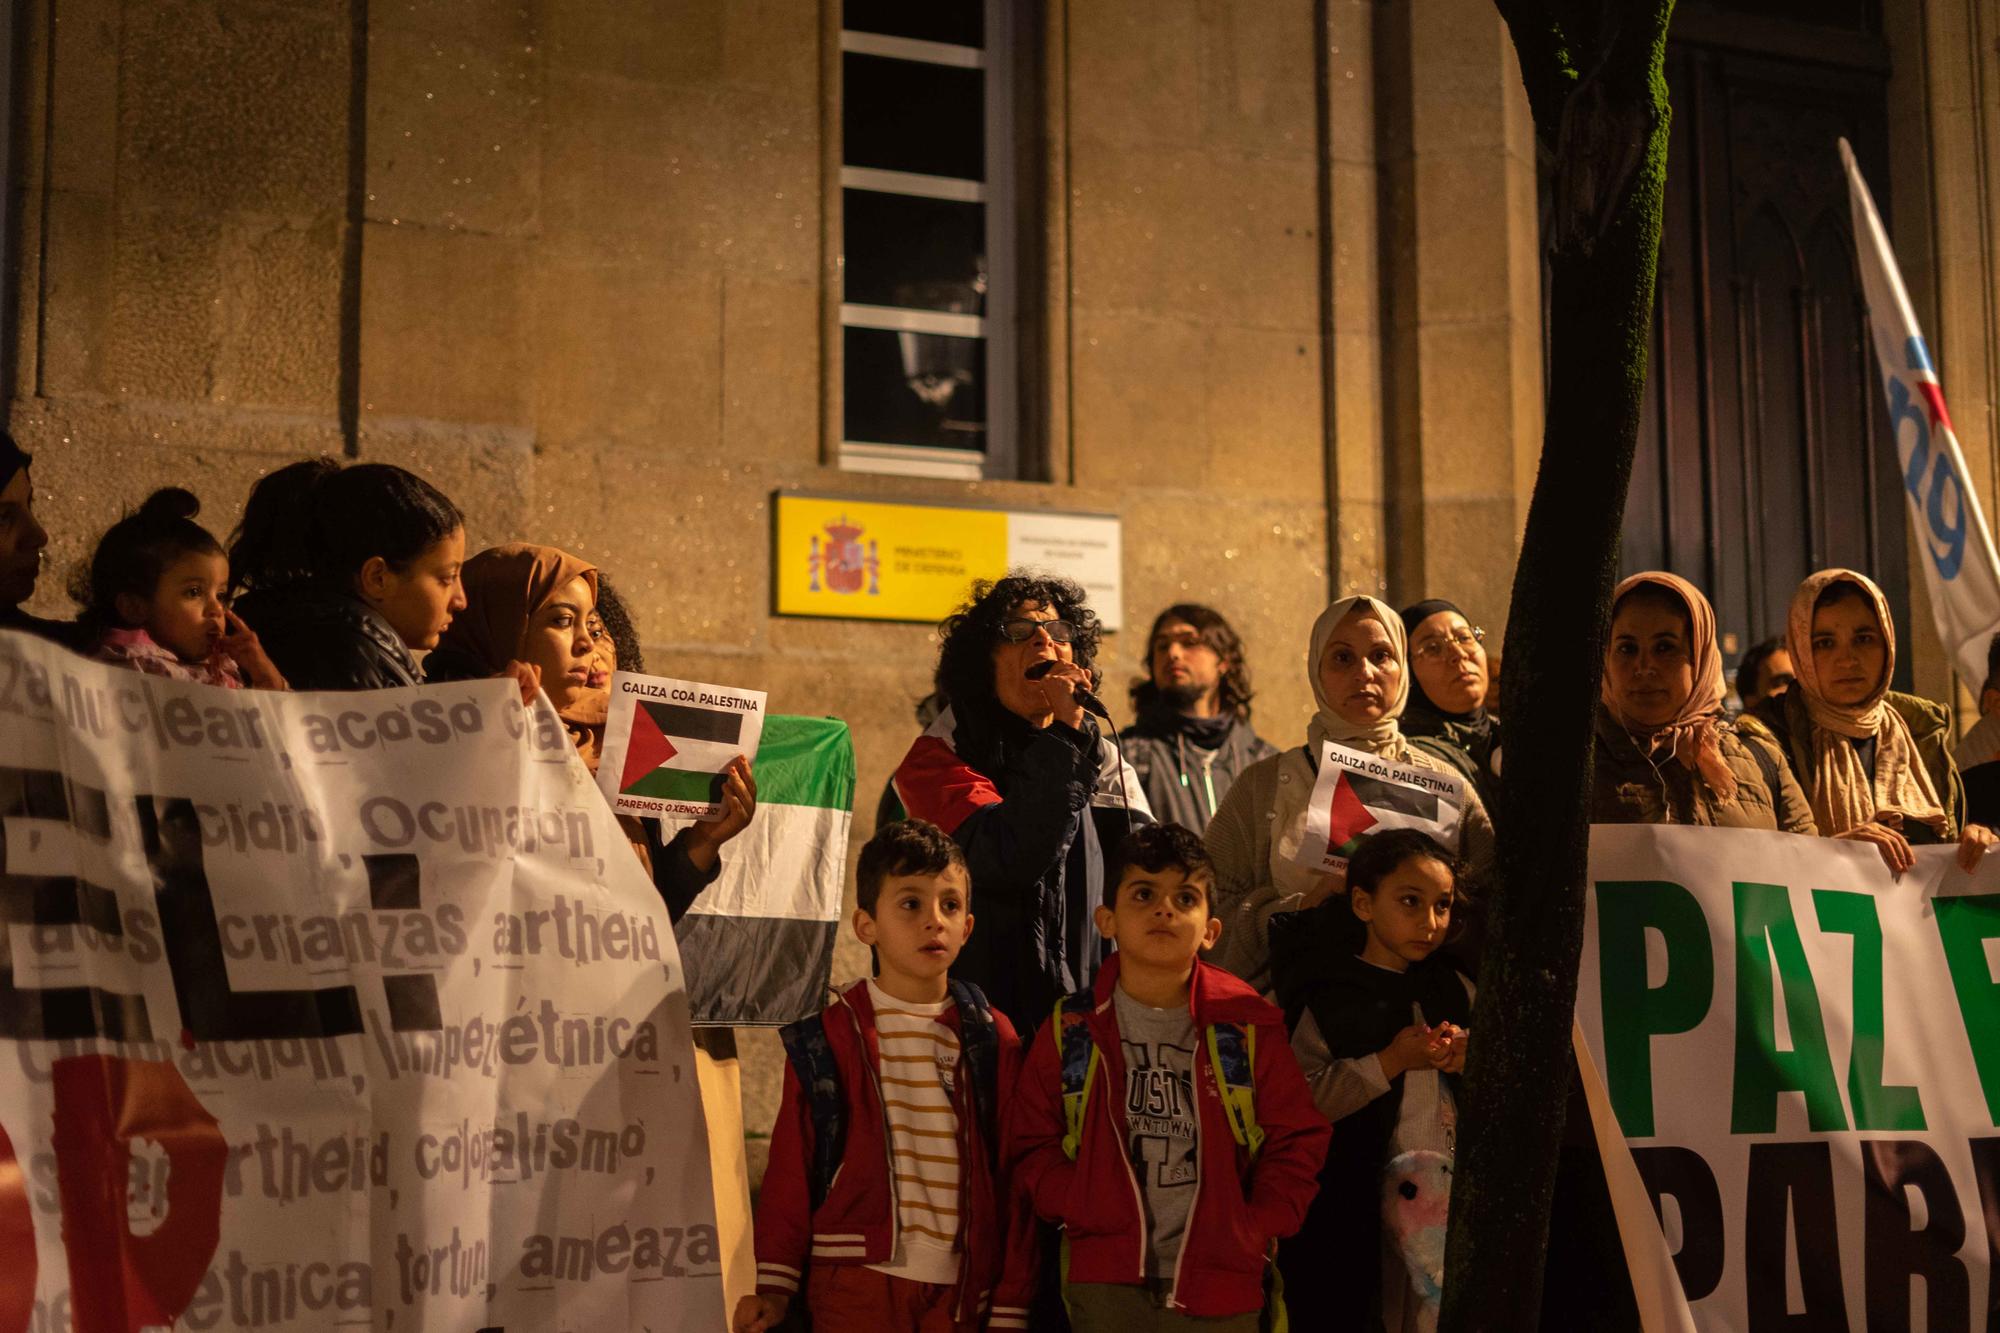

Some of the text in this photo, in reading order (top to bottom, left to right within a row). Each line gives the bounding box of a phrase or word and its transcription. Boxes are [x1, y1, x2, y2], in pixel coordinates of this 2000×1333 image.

[622, 681, 758, 712] GALIZA COA PALESTINA
[302, 698, 484, 750] acoso
[1330, 751, 1454, 795] GALIZA COA PALESTINA
[616, 798, 663, 812] PAREMOS
[665, 804, 672, 812] O
[1595, 880, 1929, 1138] PAZ
